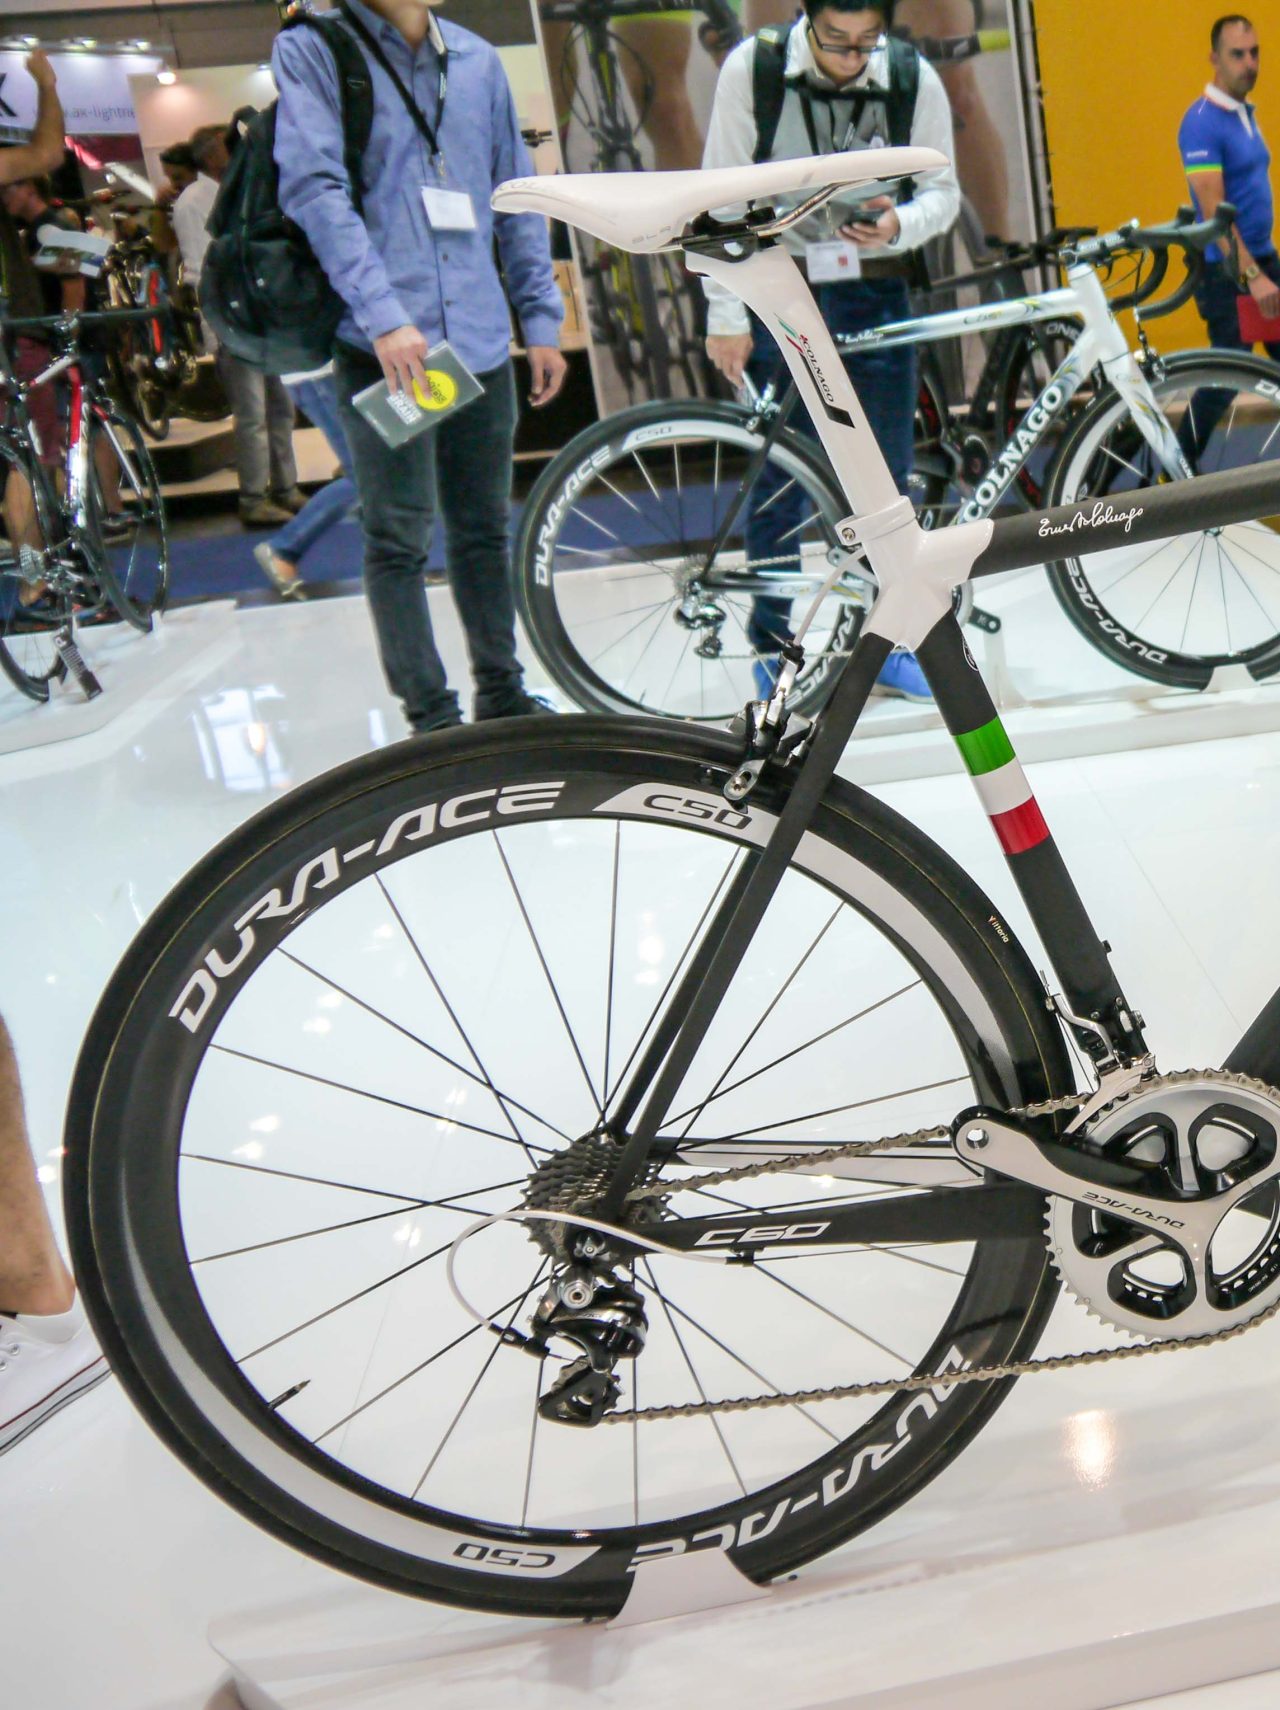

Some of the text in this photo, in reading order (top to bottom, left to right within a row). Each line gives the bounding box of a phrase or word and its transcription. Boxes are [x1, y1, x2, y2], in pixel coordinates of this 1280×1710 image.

[803, 340, 834, 403] COLNAGO
[963, 385, 1062, 522] COLNAGO
[535, 445, 611, 586] DURA-ACE
[1064, 557, 1168, 663] DURA-ACE
[642, 794, 753, 831] C50
[168, 781, 566, 1034] DURA-ACE
[988, 915, 1009, 943] Vittoria
[694, 1221, 832, 1247] C60
[1082, 1191, 1187, 1229] DURA-ACE
[626, 1345, 972, 1573] DURA-ACE
[452, 1542, 556, 1569] C50
